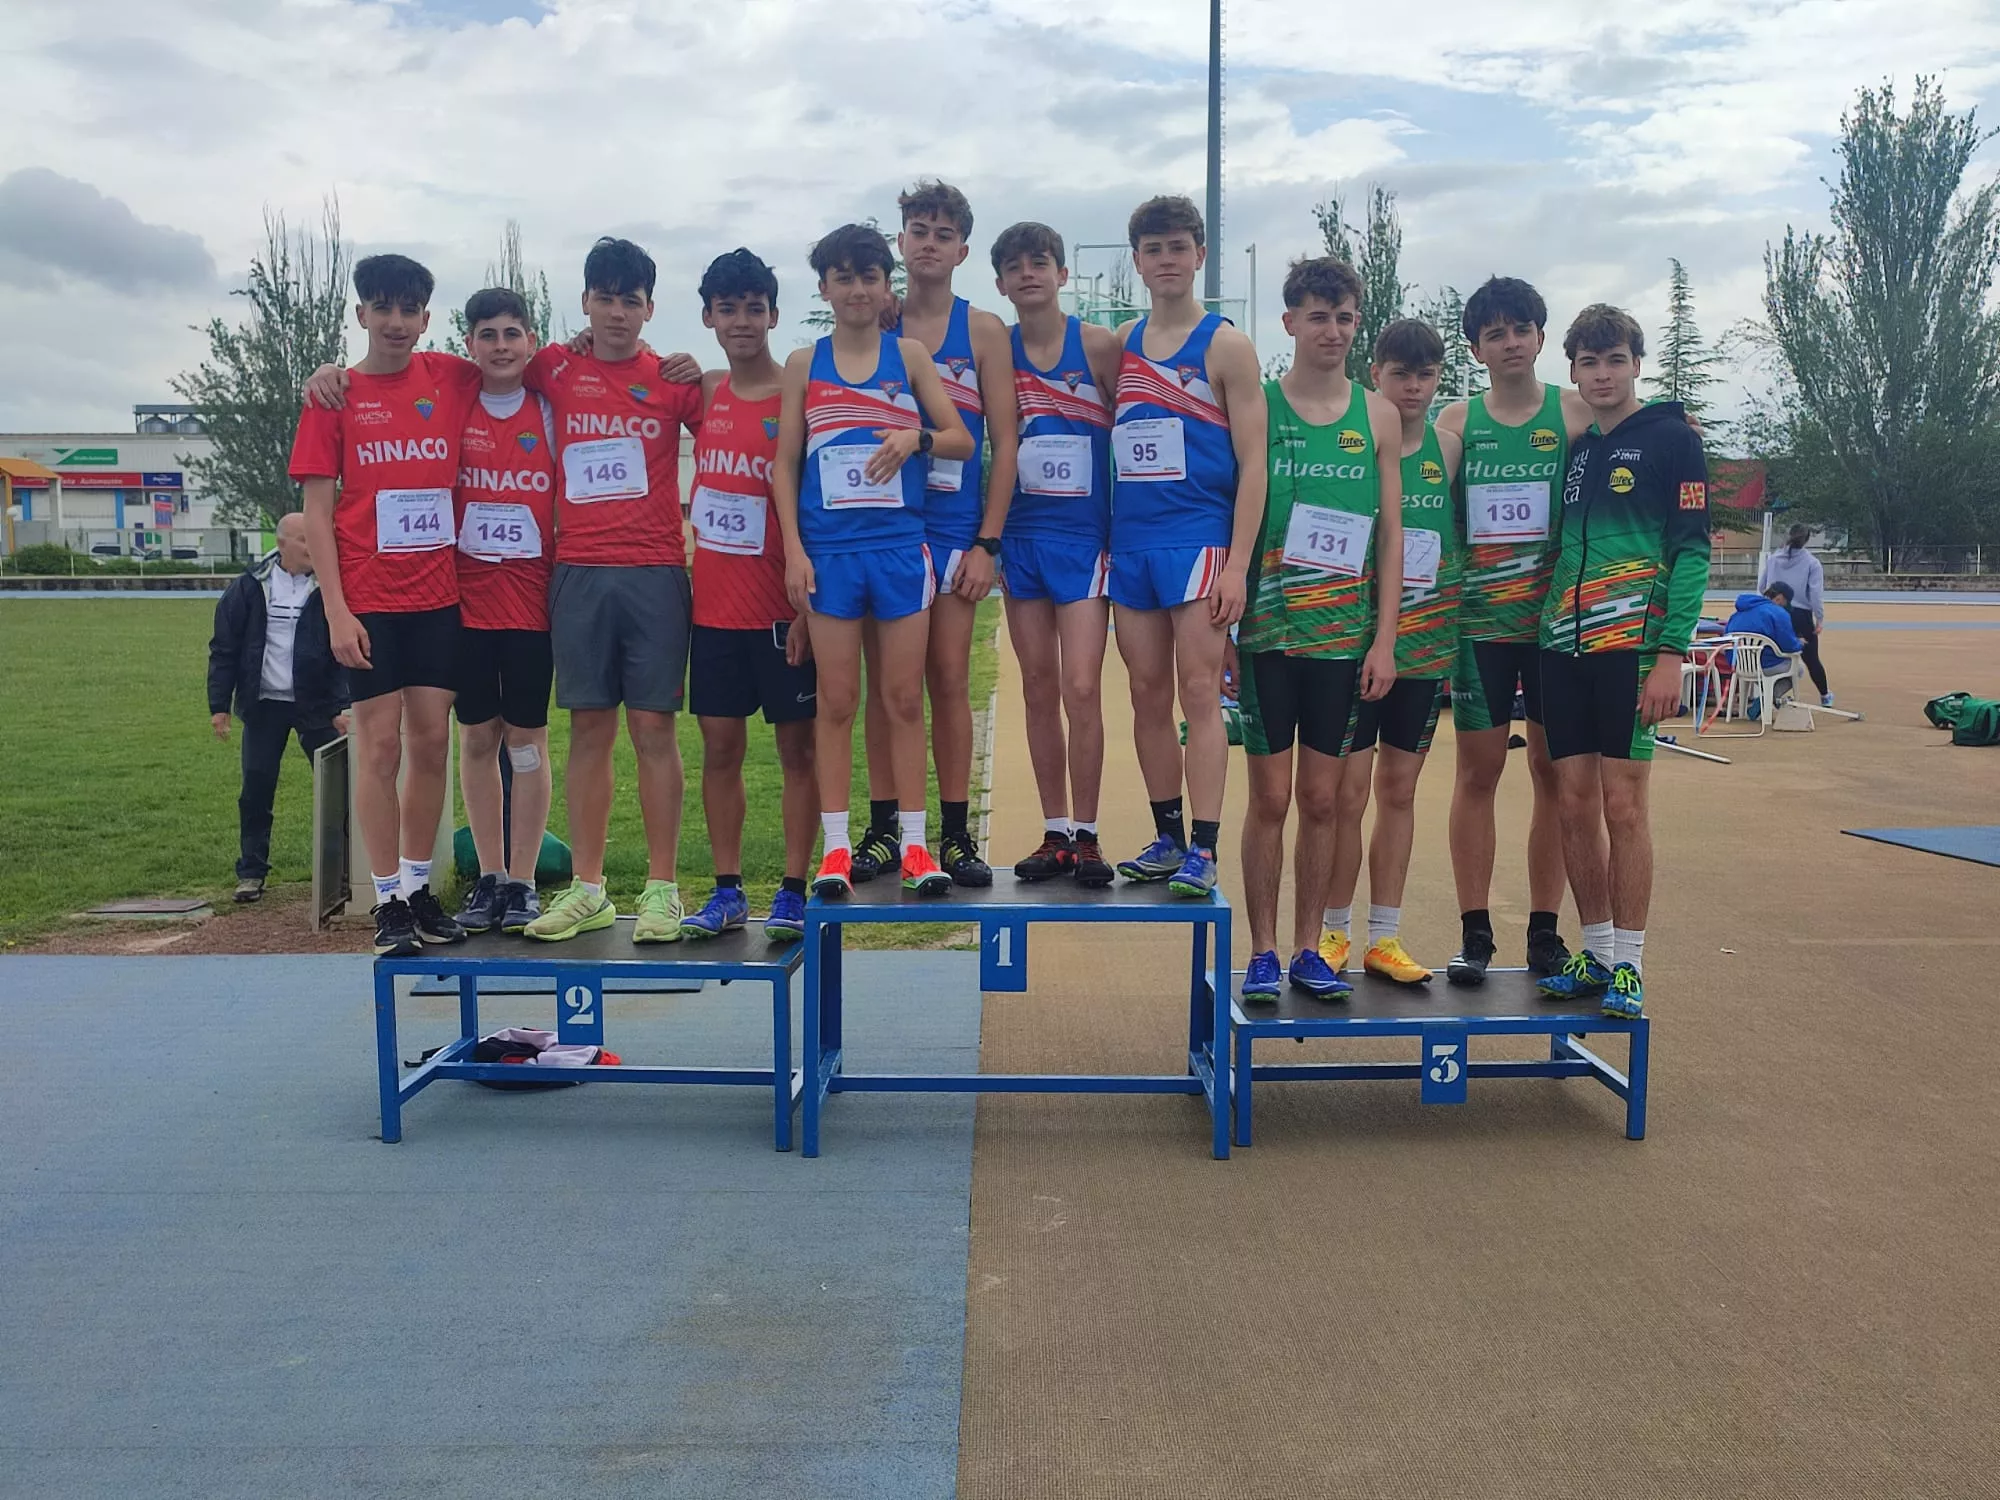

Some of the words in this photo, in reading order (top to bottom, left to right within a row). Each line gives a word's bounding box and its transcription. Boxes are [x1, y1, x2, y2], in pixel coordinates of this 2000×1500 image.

[566, 412, 661, 440] HINACO
[356, 437, 449, 466] HINACO
[1132, 443, 1158, 462] 95
[583, 462, 628, 484] 146
[846, 468, 875, 488] 9
[1042, 461, 1071, 480] 96
[1273, 458, 1366, 480] Huesca
[1465, 460, 1559, 478] Huesca
[1402, 494, 1444, 509] esca
[1487, 503, 1531, 522] 130
[398, 512, 441, 533] 144
[704, 510, 746, 532] 143
[477, 523, 523, 543] 145
[1307, 531, 1349, 556] 131
[992, 927, 1012, 967] 1
[565, 985, 594, 1024] 2
[1430, 1044, 1460, 1083] 3
